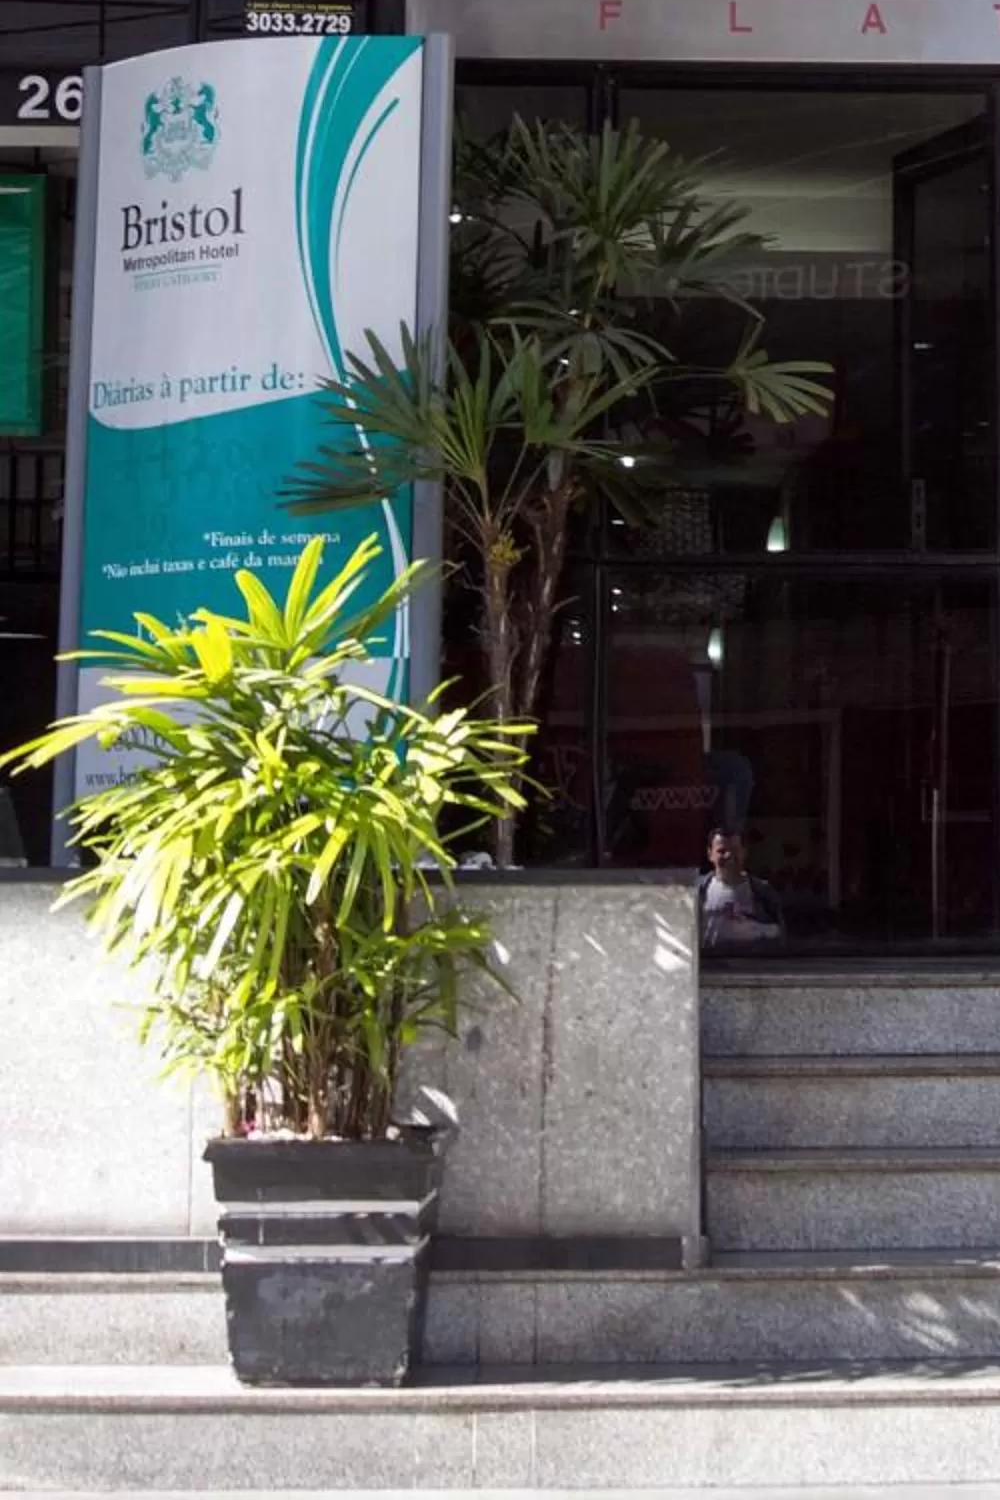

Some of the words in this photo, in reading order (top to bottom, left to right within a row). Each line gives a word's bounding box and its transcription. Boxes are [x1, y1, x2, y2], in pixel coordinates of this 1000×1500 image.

[245, 11, 352, 34] 3033.2729
[120, 185, 245, 252] Bristol
[123, 247, 196, 273] Metropolitan
[199, 243, 240, 260] Hotel
[93, 377, 154, 410] Diárias
[179, 364, 252, 402] partir
[257, 528, 277, 545] de
[209, 551, 240, 570] café
[243, 551, 264, 568] da
